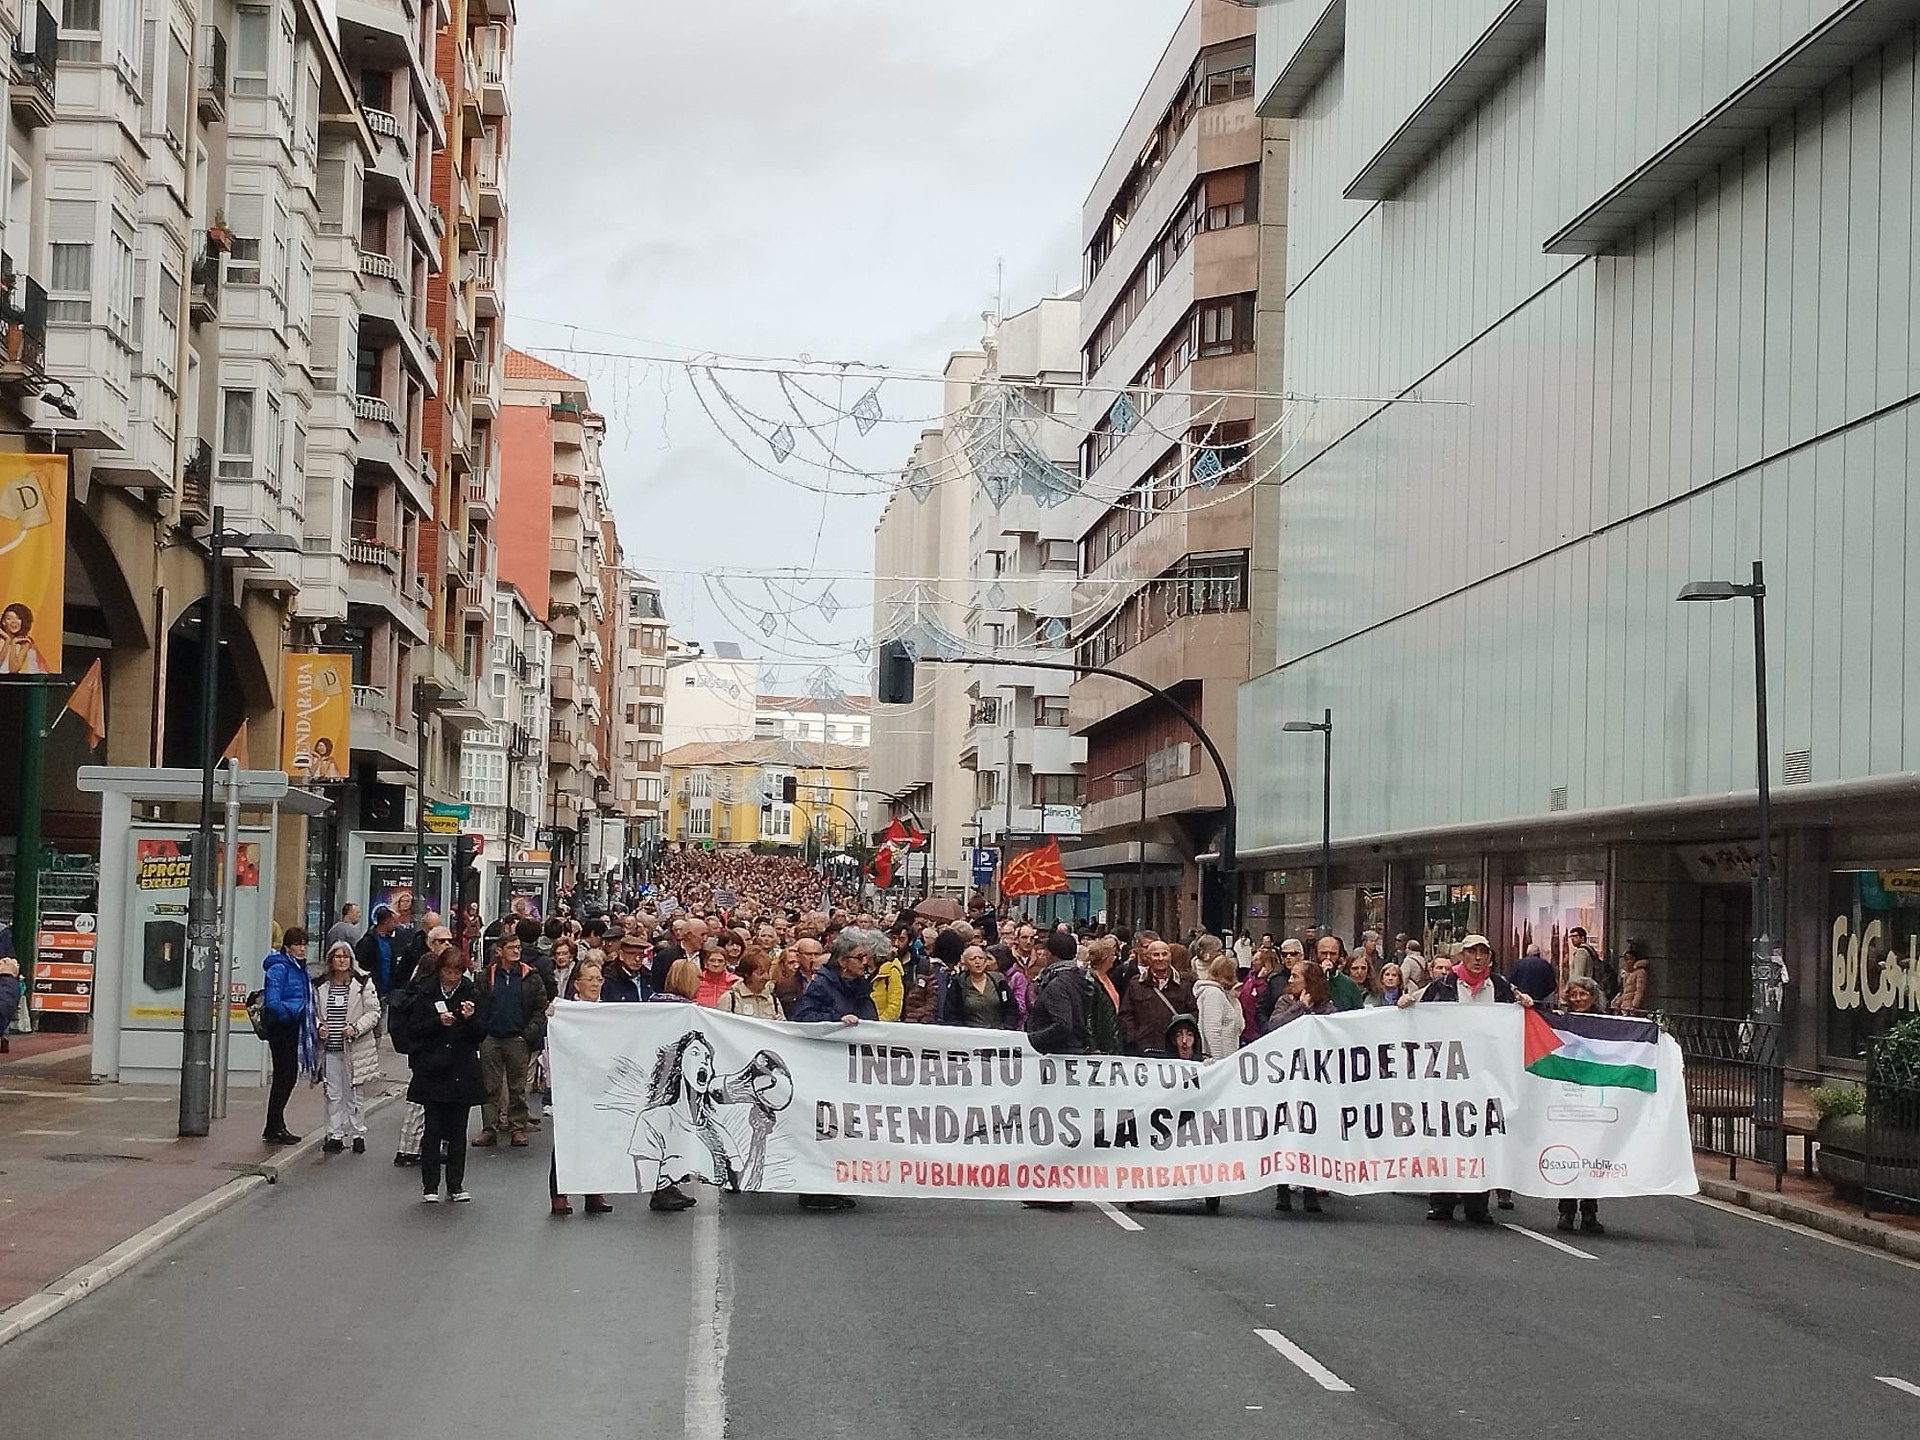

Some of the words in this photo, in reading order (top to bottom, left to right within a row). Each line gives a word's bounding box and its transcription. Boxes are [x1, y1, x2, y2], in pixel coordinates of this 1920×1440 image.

[16, 485, 39, 512] D
[323, 670, 337, 686] D
[293, 663, 313, 768] DENDARABA
[848, 1044, 1022, 1087] INDARTU
[1039, 1057, 1200, 1090] DEZAGUN
[1238, 1040, 1471, 1085] OSAKIDETZA
[816, 1100, 1082, 1149] DEFENDAMOS
[1093, 1108, 1140, 1149] LA
[1149, 1100, 1317, 1151] SANIDAD
[1340, 1097, 1507, 1142] PUBLICA
[836, 1160, 891, 1184] DIRU
[900, 1161, 1010, 1188] PUBLIKOA
[1016, 1162, 1108, 1190] OSASUN
[1115, 1161, 1247, 1190] PRIBATURA
[1259, 1151, 1449, 1184] DESBIDERATZEARI
